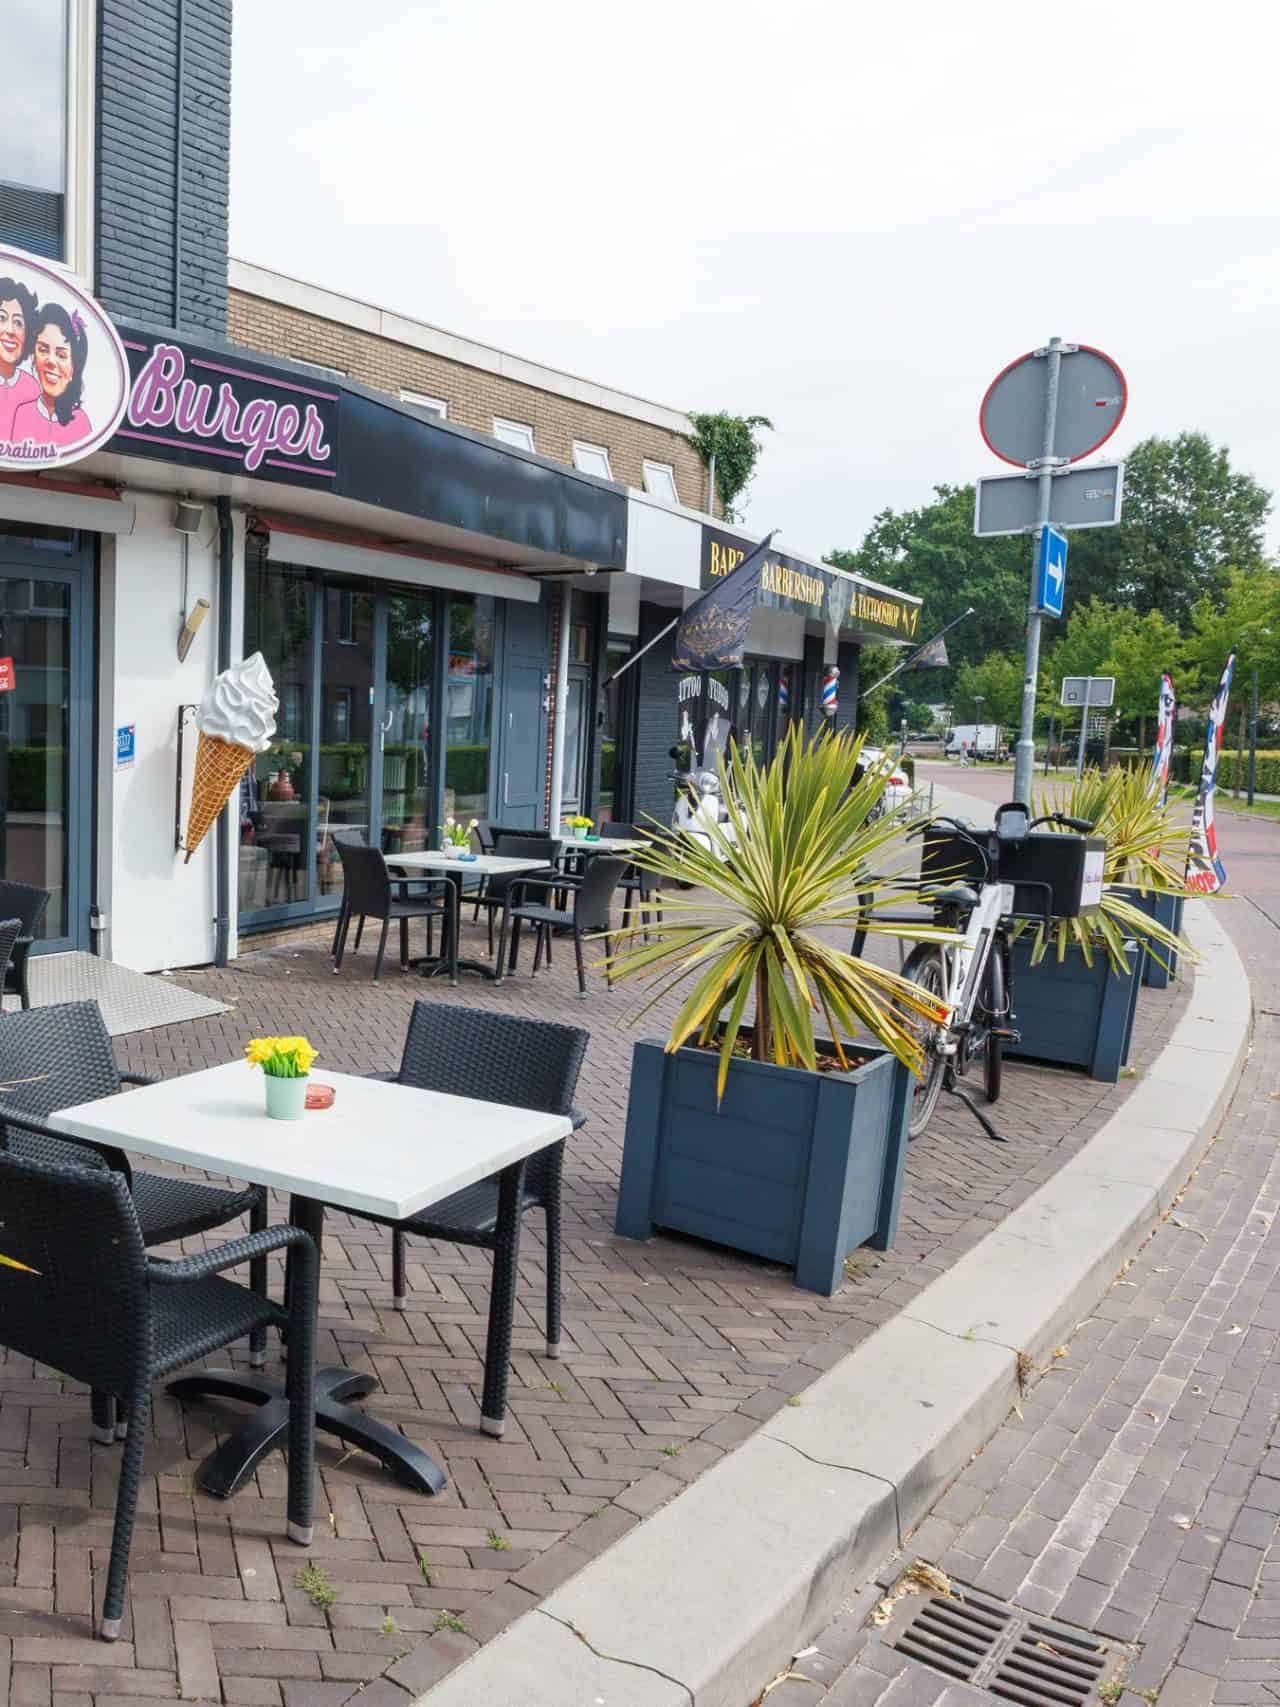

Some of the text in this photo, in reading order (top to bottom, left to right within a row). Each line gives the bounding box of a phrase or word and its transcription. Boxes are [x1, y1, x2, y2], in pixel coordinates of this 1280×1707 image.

[128, 343, 330, 471] Burger
[761, 560, 825, 607] BARBERSHOP
[858, 593, 900, 628] TATTOOSHOP
